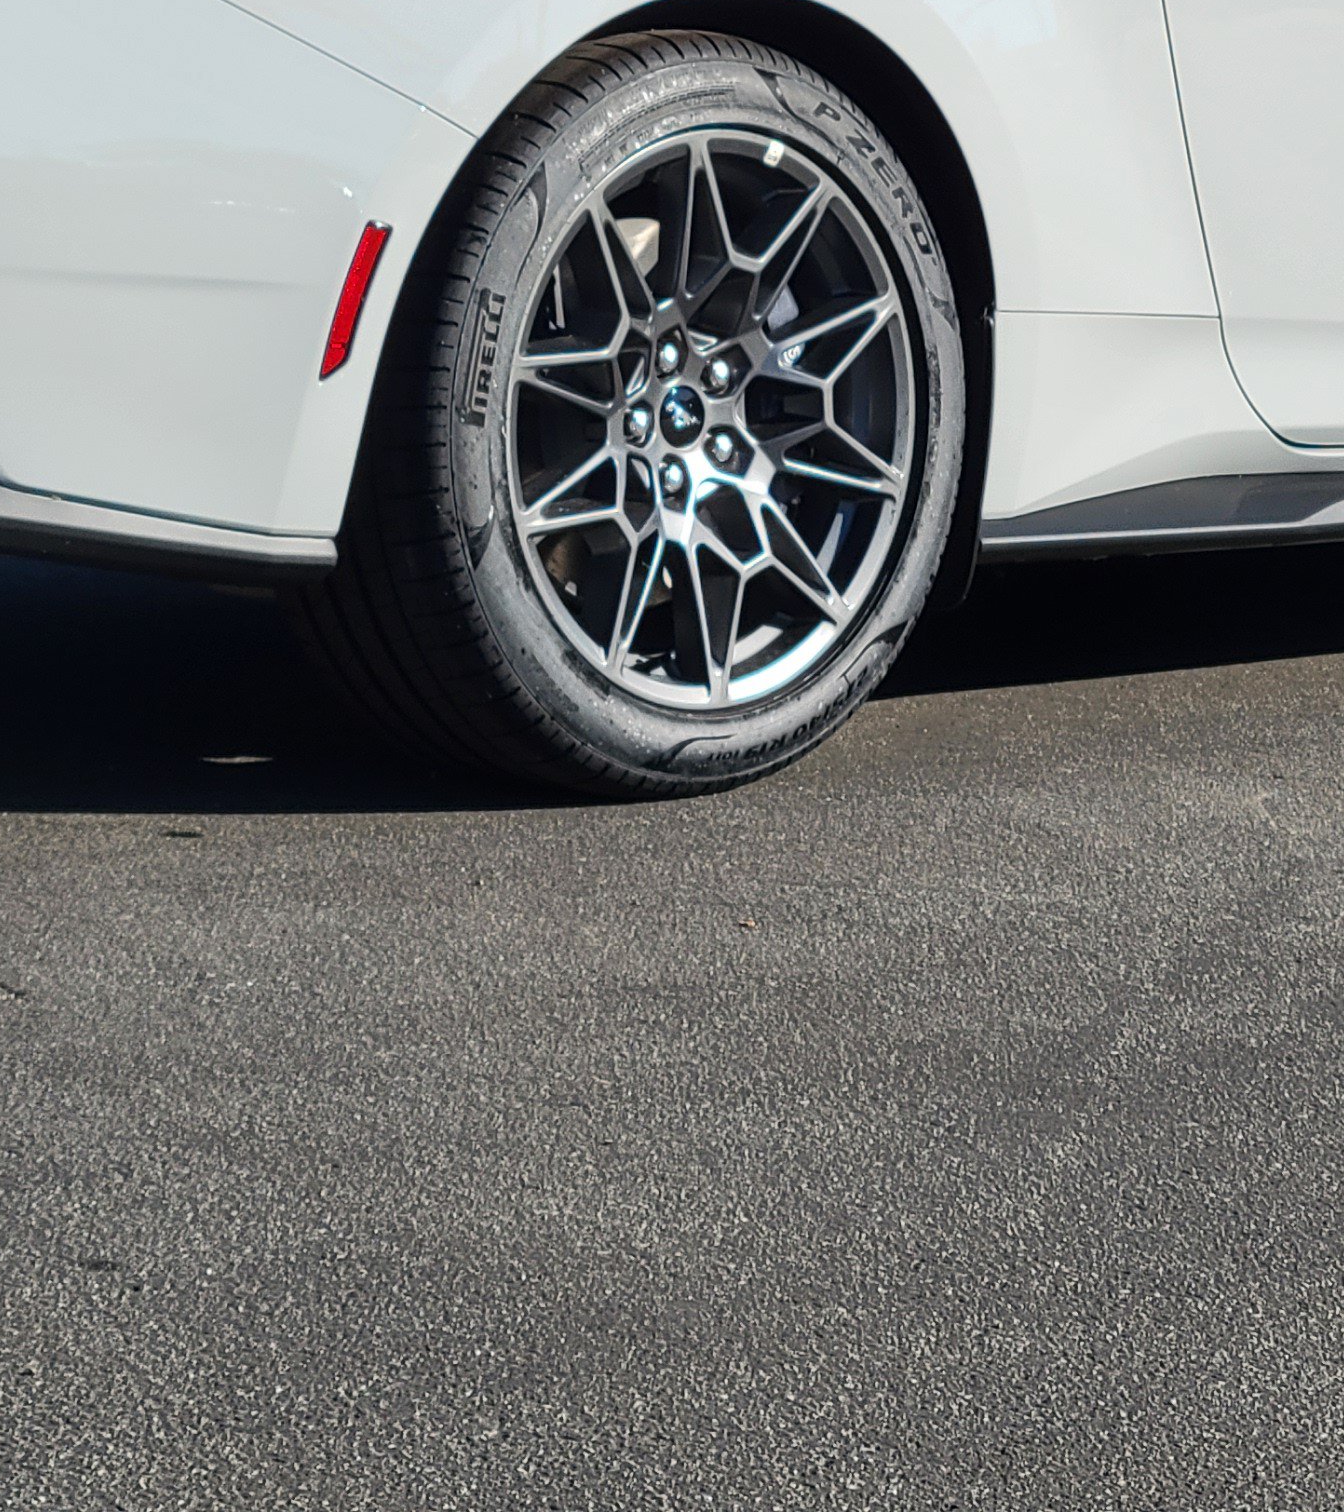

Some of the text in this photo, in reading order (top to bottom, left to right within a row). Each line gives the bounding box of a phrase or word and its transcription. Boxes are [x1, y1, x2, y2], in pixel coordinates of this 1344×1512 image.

[813, 101, 934, 255] P ZERO
[457, 287, 507, 428] PIRELLI
